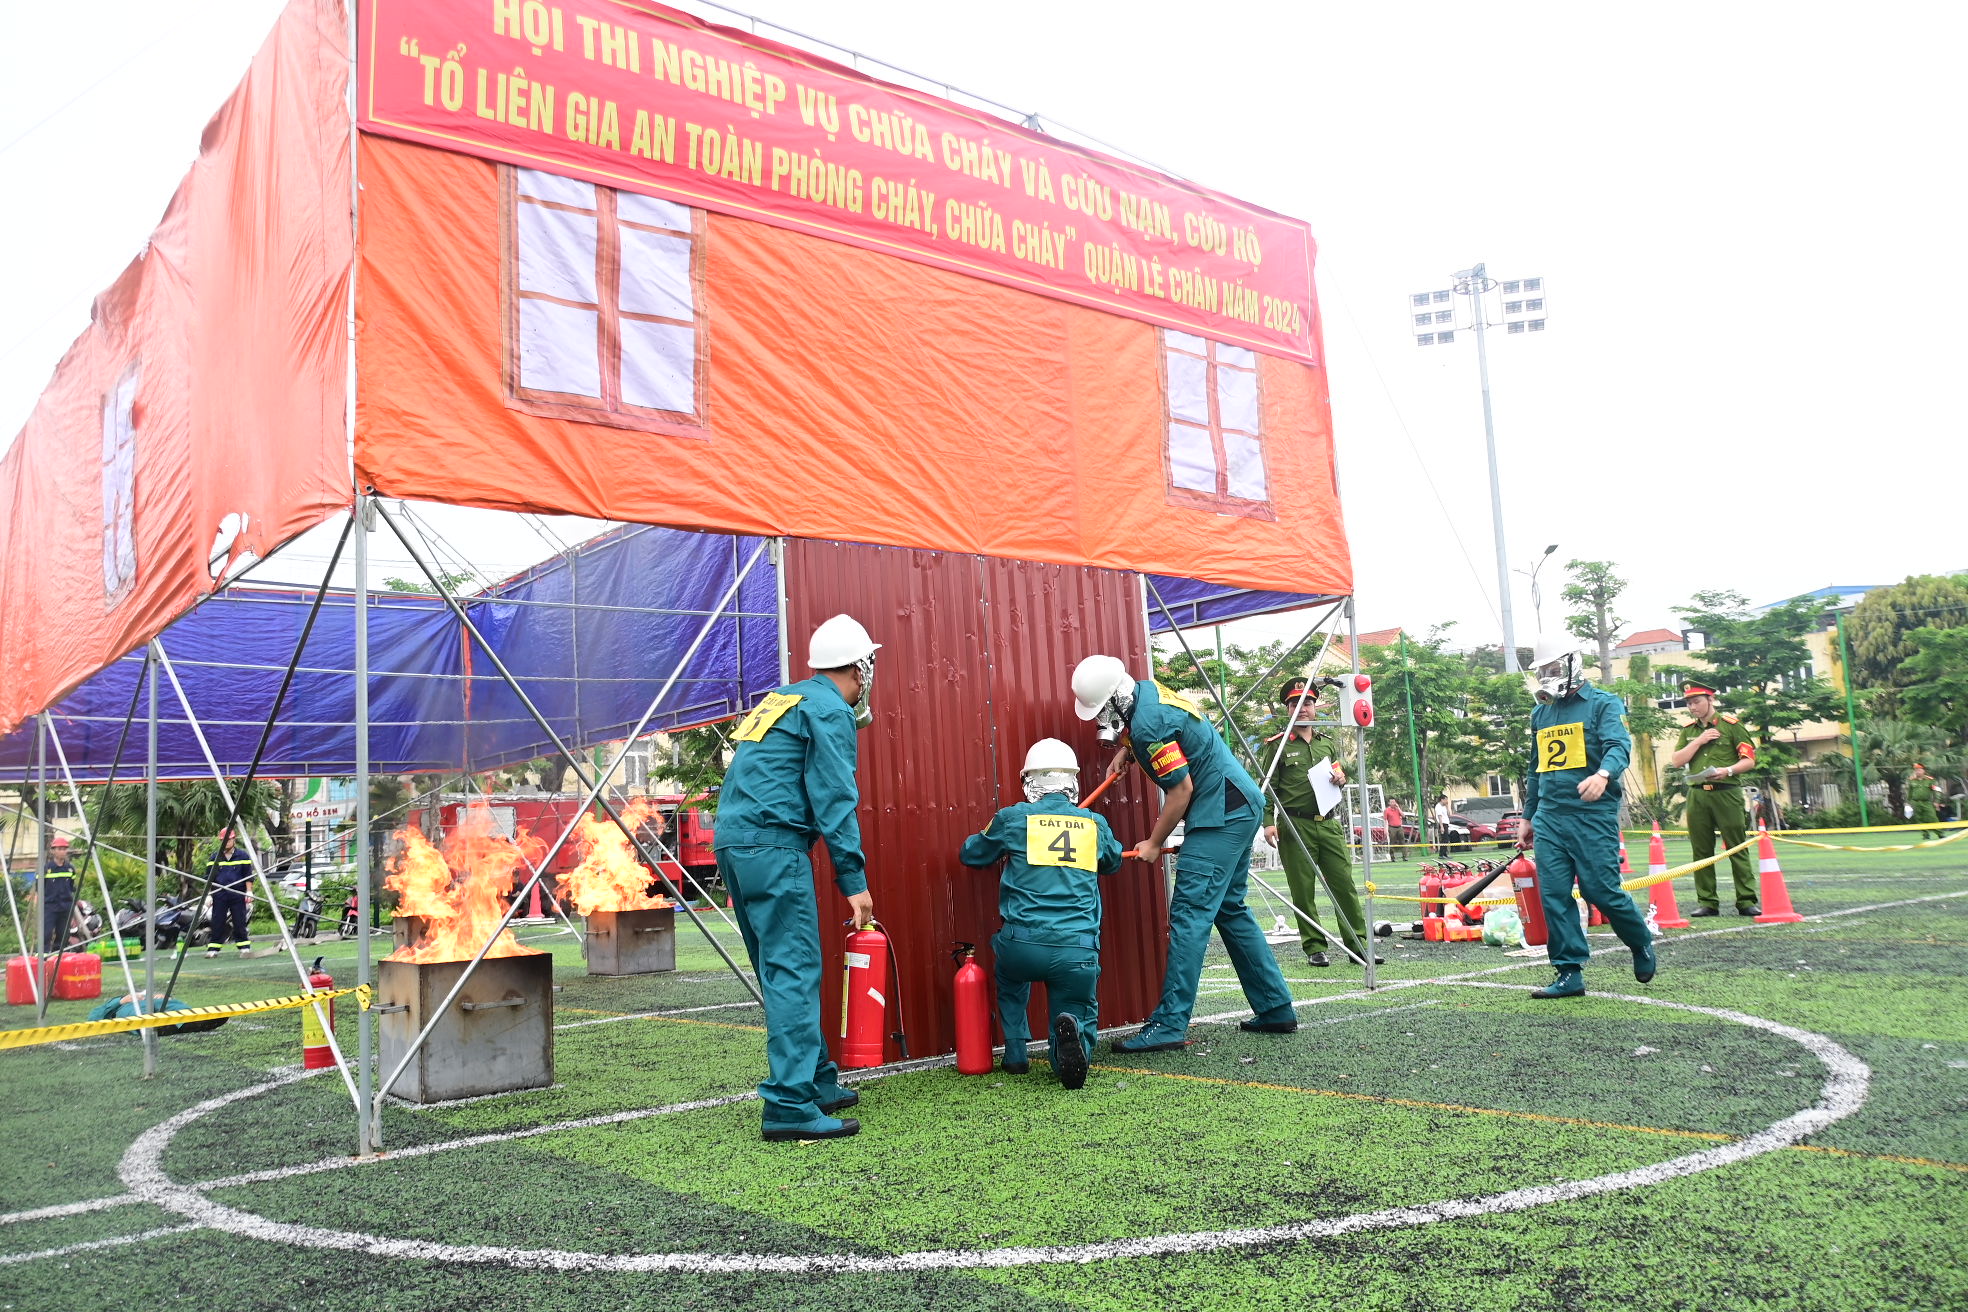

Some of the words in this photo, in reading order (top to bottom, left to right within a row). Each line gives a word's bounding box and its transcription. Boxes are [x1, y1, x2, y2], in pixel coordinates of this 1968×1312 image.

[576, 15, 640, 74] THI
[652, 38, 786, 119] NGHIỆP
[796, 83, 840, 142] VỤ
[849, 103, 934, 163] CHỮA
[941, 132, 1012, 189] CHÁY
[1020, 158, 1056, 205] VÀ
[1061, 173, 1112, 221] CỨU
[1119, 191, 1179, 246] NẠN,
[1184, 211, 1227, 256] CỨU
[1232, 226, 1262, 272] HỘ
[476, 66, 555, 134] LIÊN
[566, 92, 621, 151] GIA
[630, 109, 676, 164] AN
[686, 122, 762, 187] TOÀN
[772, 147, 863, 213] PHÒNG
[871, 176, 938, 240] CHÁY,
[945, 198, 1006, 254] CHỮA
[1084, 242, 1138, 295] QUẬN
[1142, 255, 1165, 298] LÊ
[1168, 267, 1218, 313] CHÂN
[1222, 278, 1260, 325] NĂM
[1263, 295, 1300, 336] 2024
[1547, 739, 1568, 768] 2
[1039, 817, 1062, 828] CÁT
[1047, 830, 1077, 863] 4
